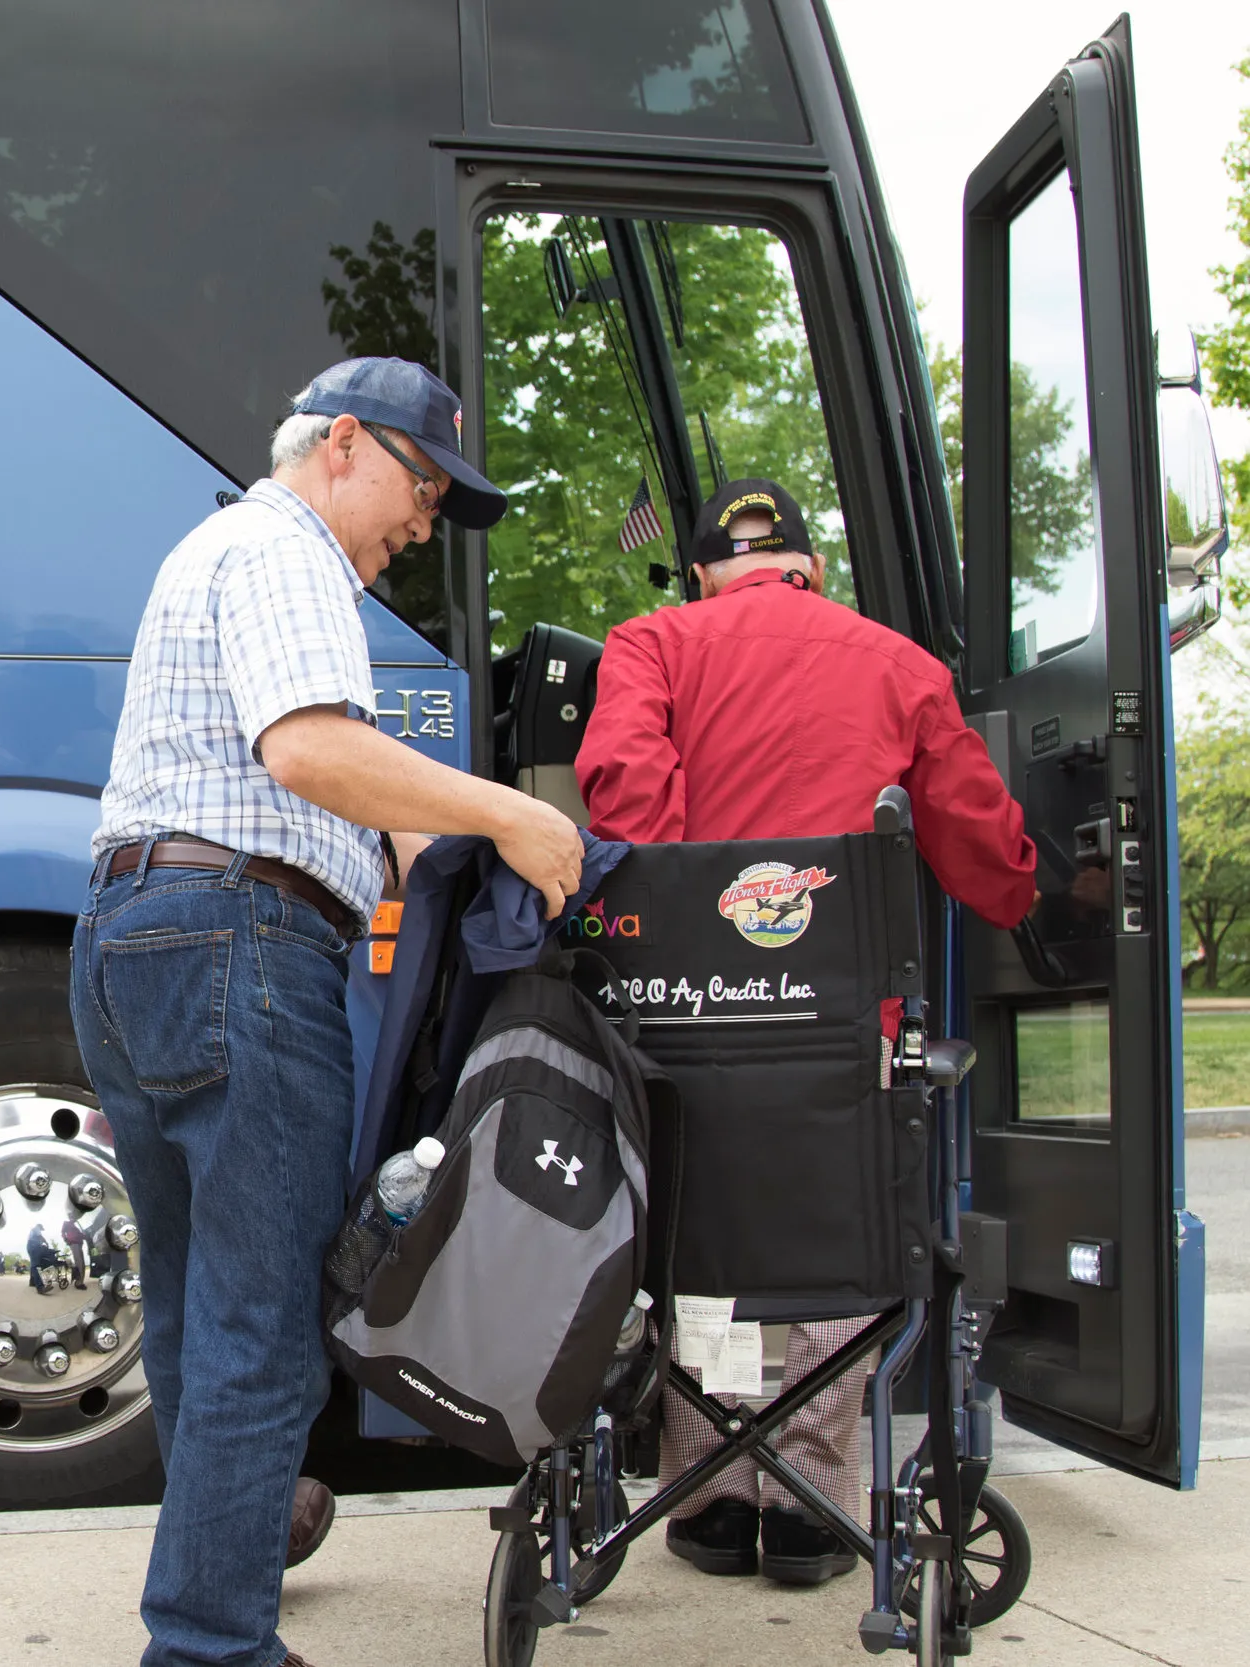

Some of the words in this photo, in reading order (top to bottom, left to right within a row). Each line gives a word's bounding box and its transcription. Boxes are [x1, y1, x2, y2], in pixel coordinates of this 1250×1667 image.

[419, 718, 455, 738] 45
[738, 862, 768, 879] CENTRAL
[769, 861, 796, 875] VALLEY
[724, 881, 767, 903] Honor
[768, 870, 813, 896] Flight
[567, 914, 640, 938] nova
[671, 977, 704, 1016] Ag
[780, 972, 816, 1000] Inc.
[399, 1369, 436, 1399] UNDER
[435, 1397, 487, 1425] ARMOUR
